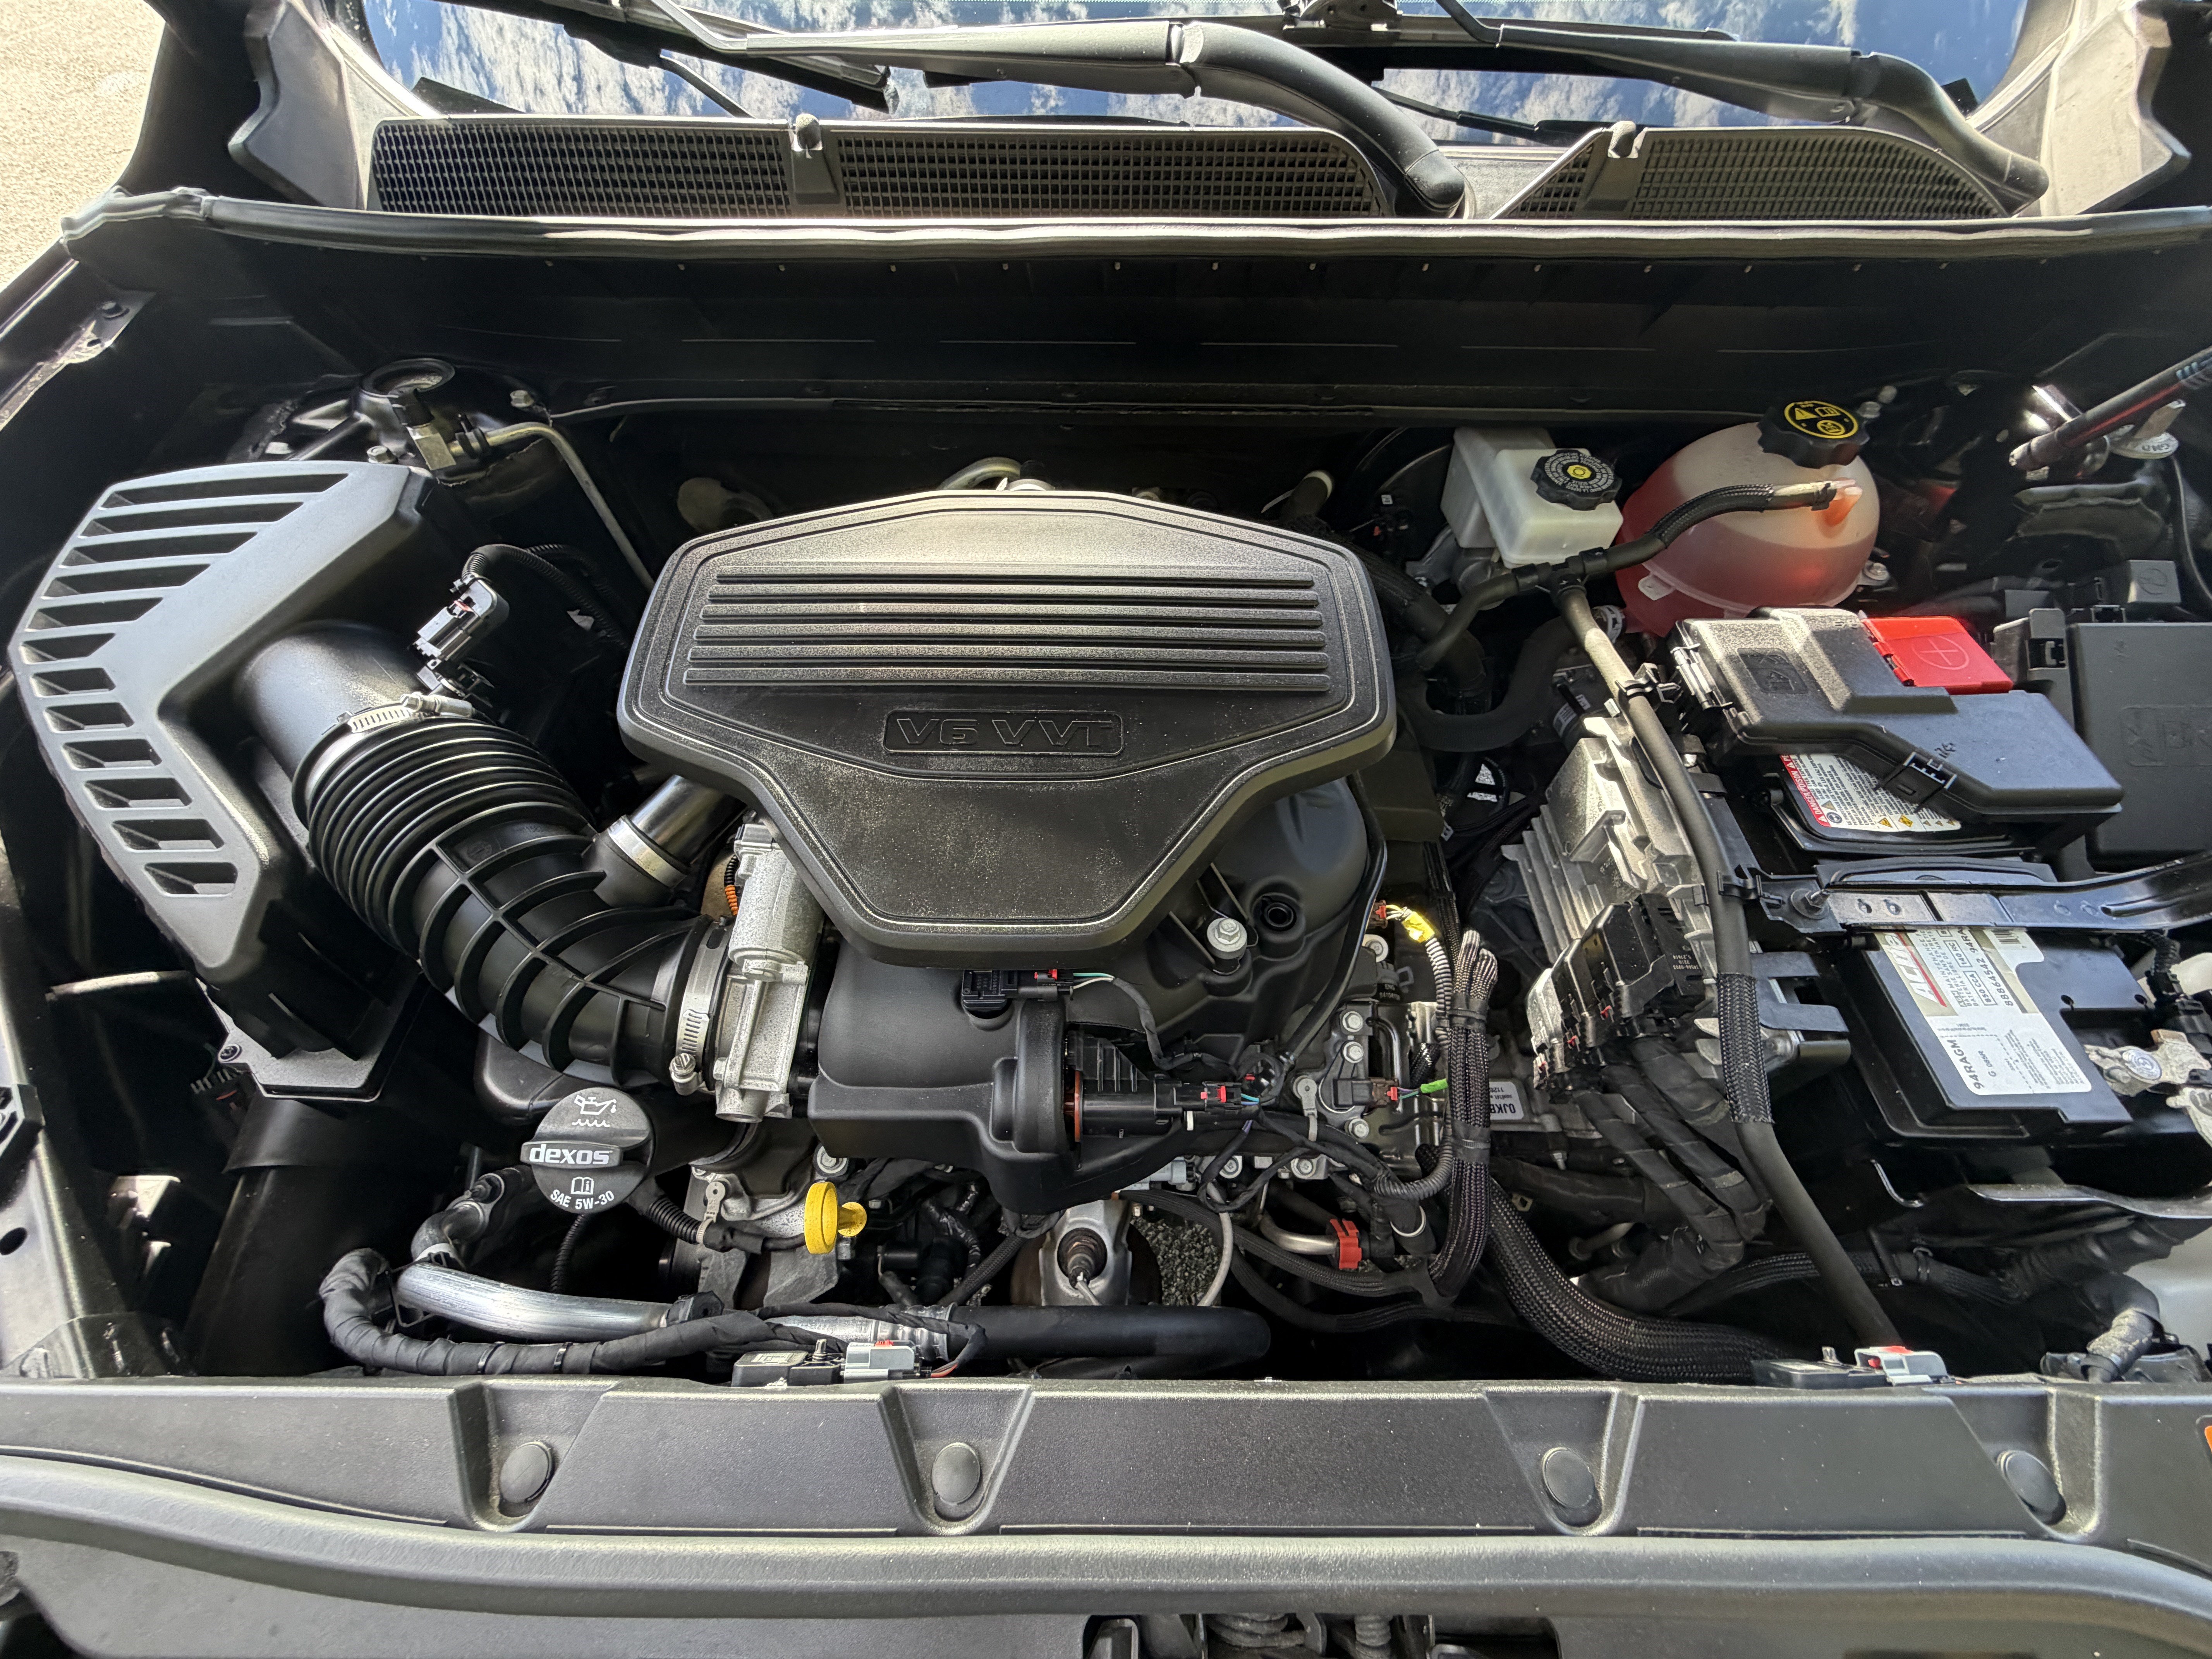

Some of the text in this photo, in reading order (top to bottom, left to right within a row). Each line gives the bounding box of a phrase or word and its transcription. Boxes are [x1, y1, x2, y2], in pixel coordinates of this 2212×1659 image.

[896, 718, 1113, 747] V6 VVT
[1793, 771, 1823, 815] DANGER/POISON
[1919, 938, 1954, 988] MAINTENANCE
[1938, 959, 1953, 975] SANS
[1946, 962, 1961, 979] LIBRE
[1948, 942, 1992, 1002] 850 CCA 140 RC
[1976, 958, 2013, 1006] 88864542
[1946, 1039, 1986, 1089] 94RAGM
[529, 1144, 610, 1165] dexos
[550, 1188, 615, 1210] SAE 5W-30
